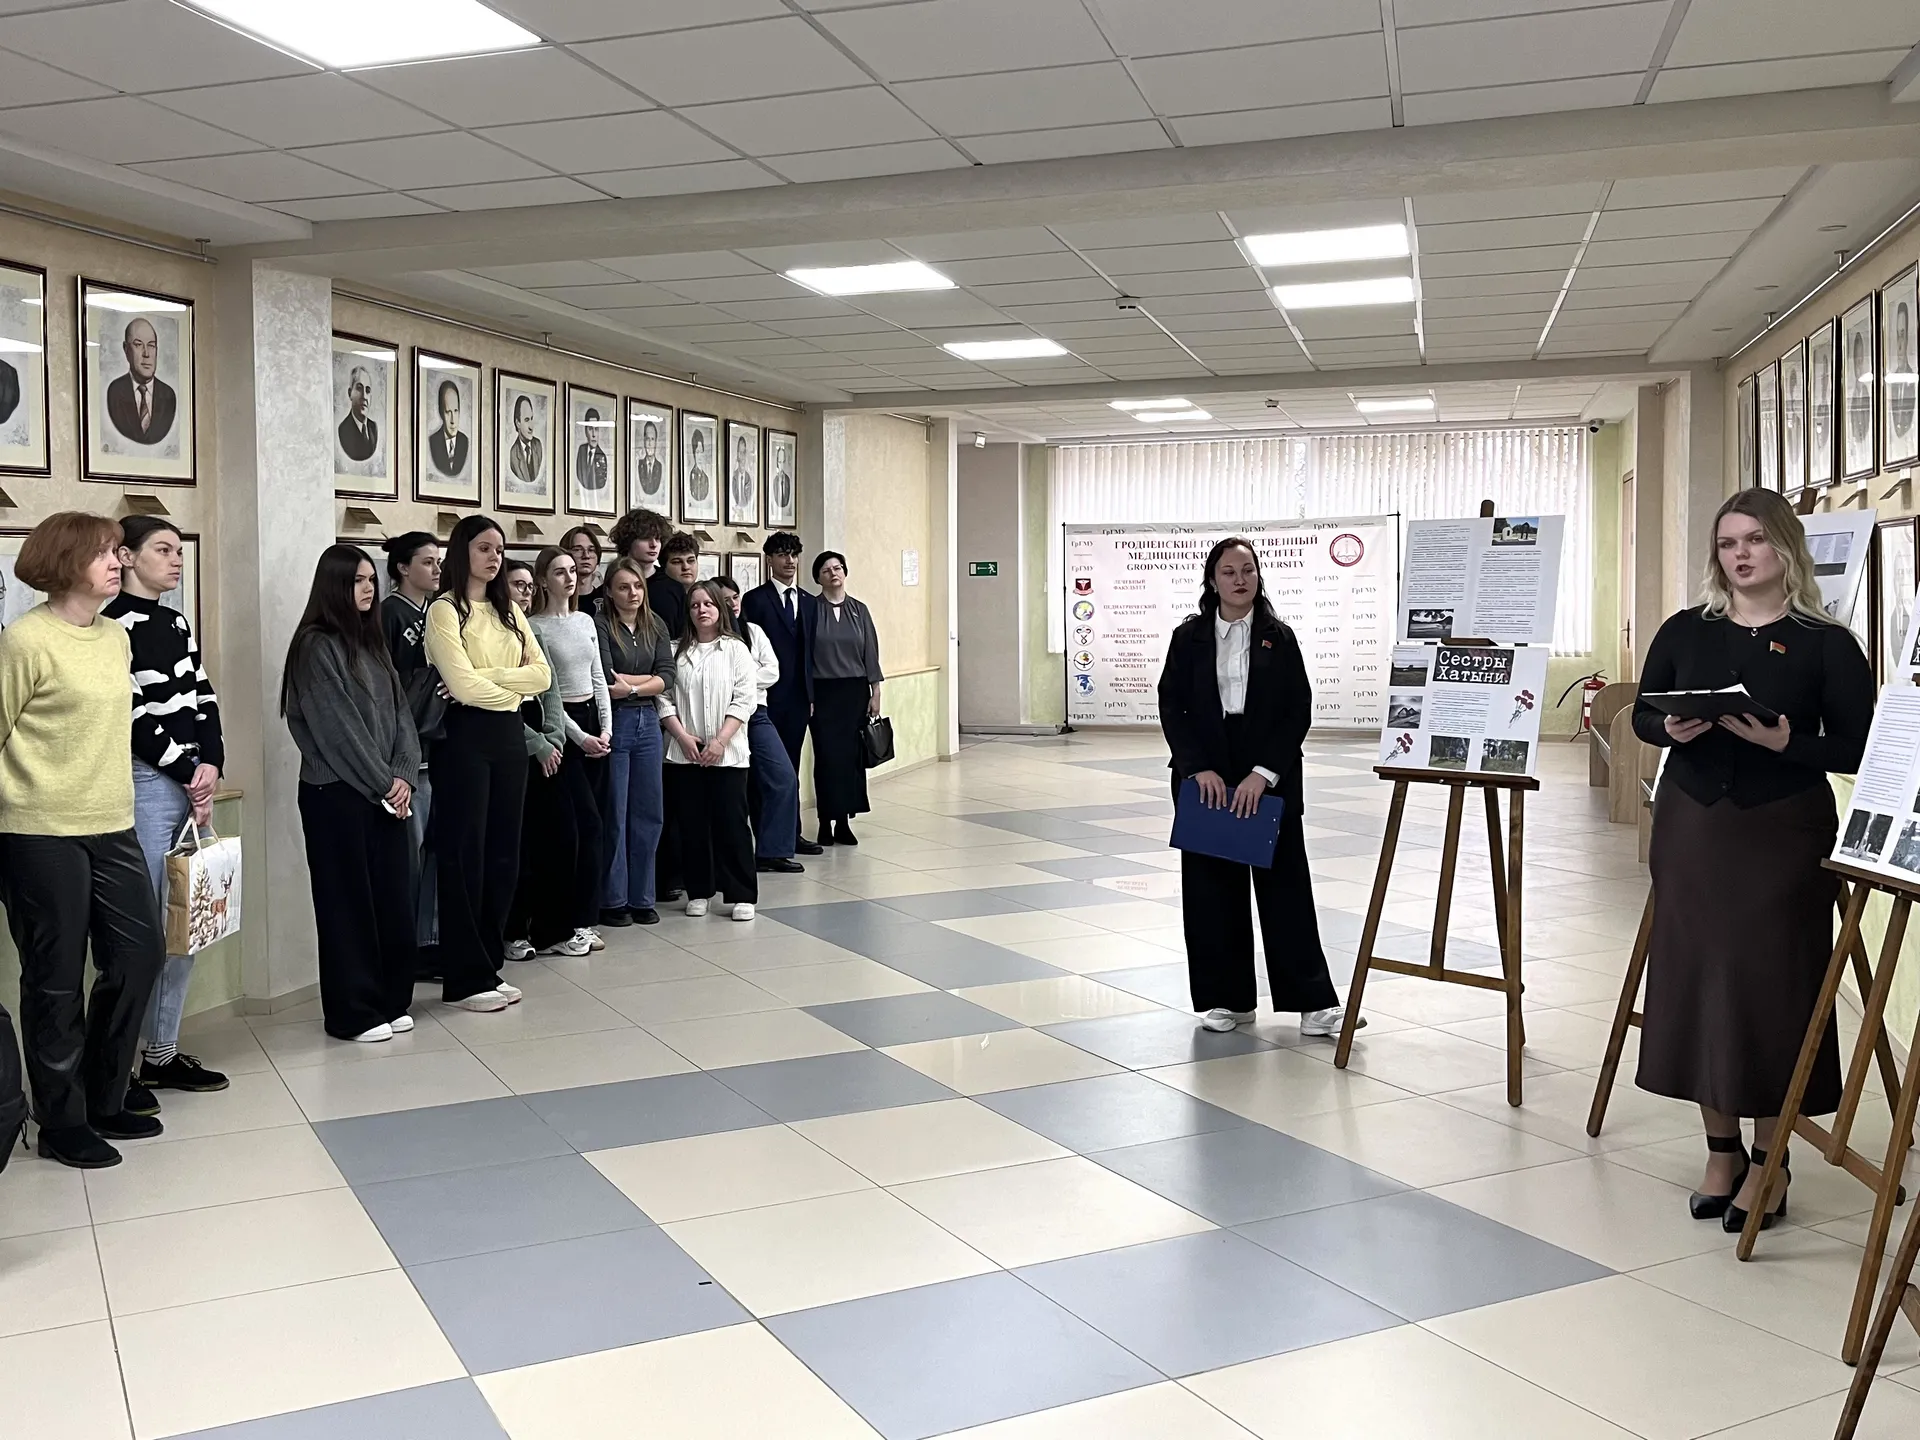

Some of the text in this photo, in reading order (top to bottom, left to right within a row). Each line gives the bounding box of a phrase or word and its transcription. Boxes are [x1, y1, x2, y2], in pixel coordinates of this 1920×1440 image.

[1114, 539, 1197, 550] ГРОДНЕНСКИЙ
[1128, 551, 1208, 561] МЕДИЦИНСКИ
[1126, 563, 1167, 571] GRODNO
[1168, 563, 1198, 571] STATE
[1259, 560, 1306, 569] IVERSITY
[1101, 632, 1159, 640] ДИАГНОСТИЧЕСКИЙ
[1438, 650, 1508, 670] Сестры
[1436, 665, 1509, 684] Хатыни.
